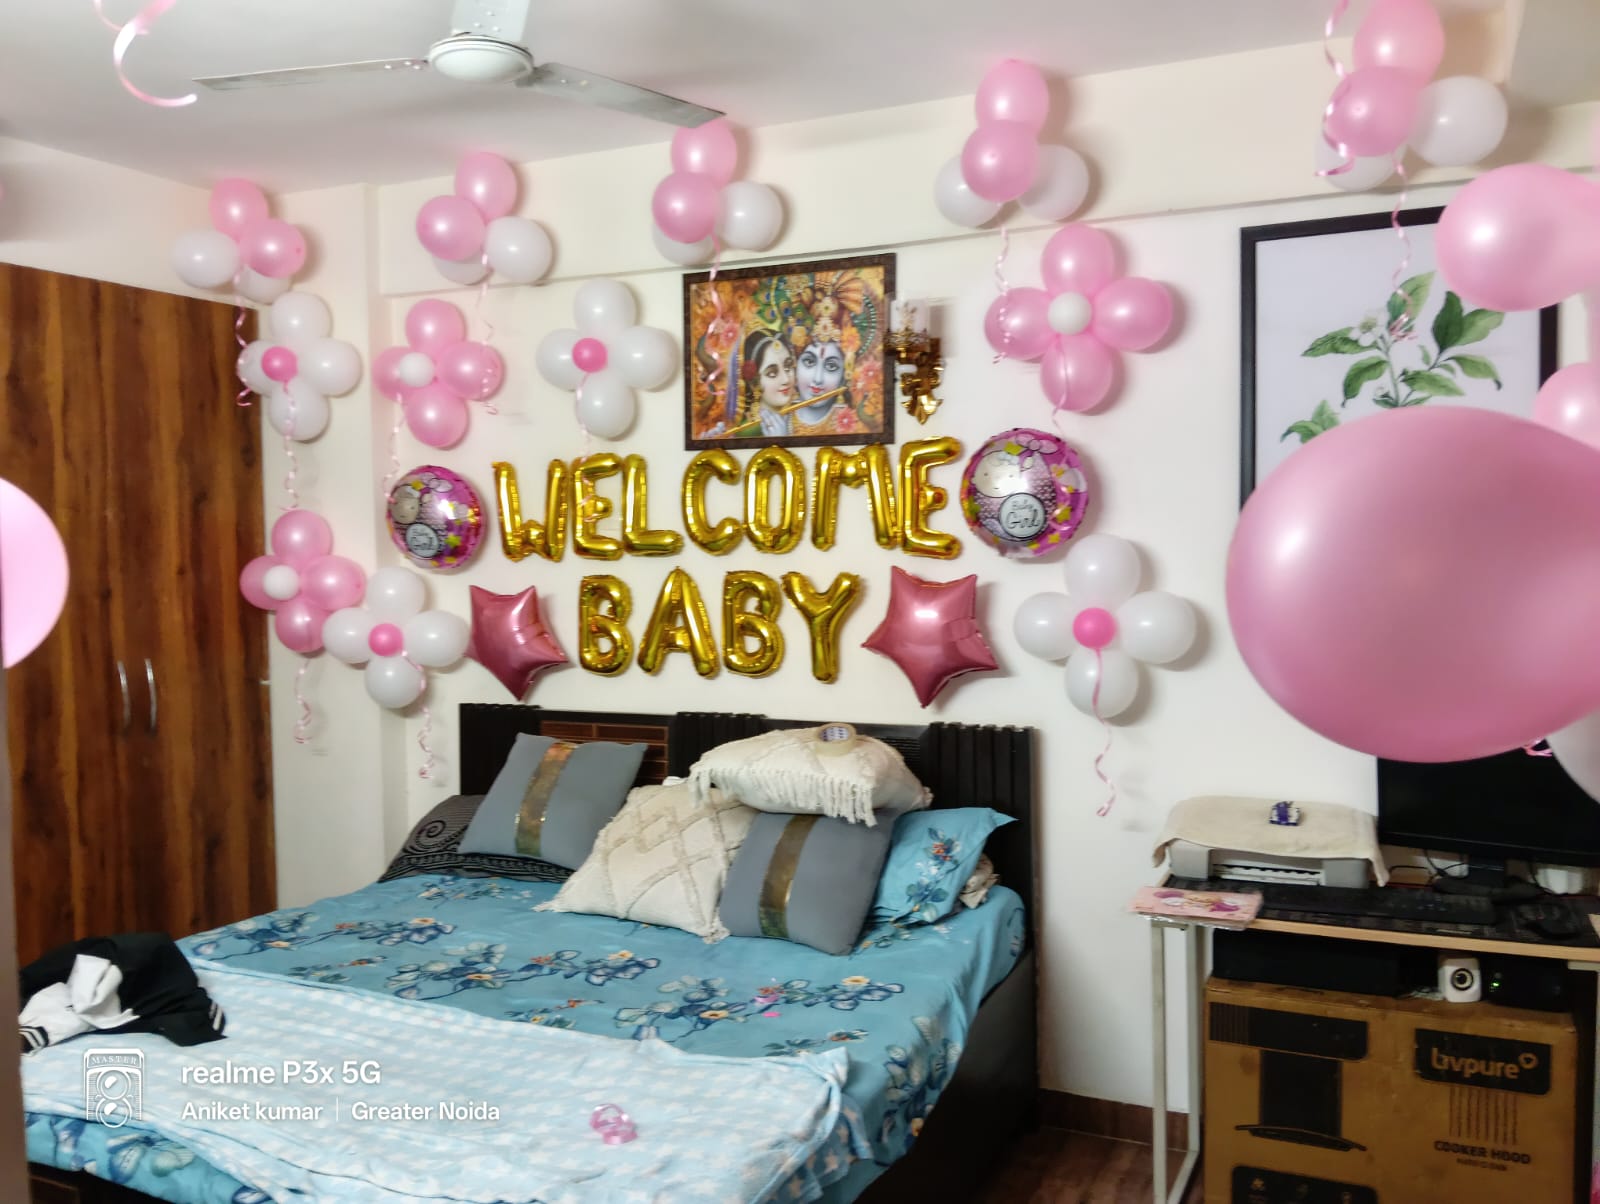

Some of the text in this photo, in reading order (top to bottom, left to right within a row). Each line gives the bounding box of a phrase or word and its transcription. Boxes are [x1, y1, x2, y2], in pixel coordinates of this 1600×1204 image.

[493, 436, 962, 561] WELCOME
[578, 565, 861, 684] BABY
[1491, 1149, 1531, 1164] HOOD
